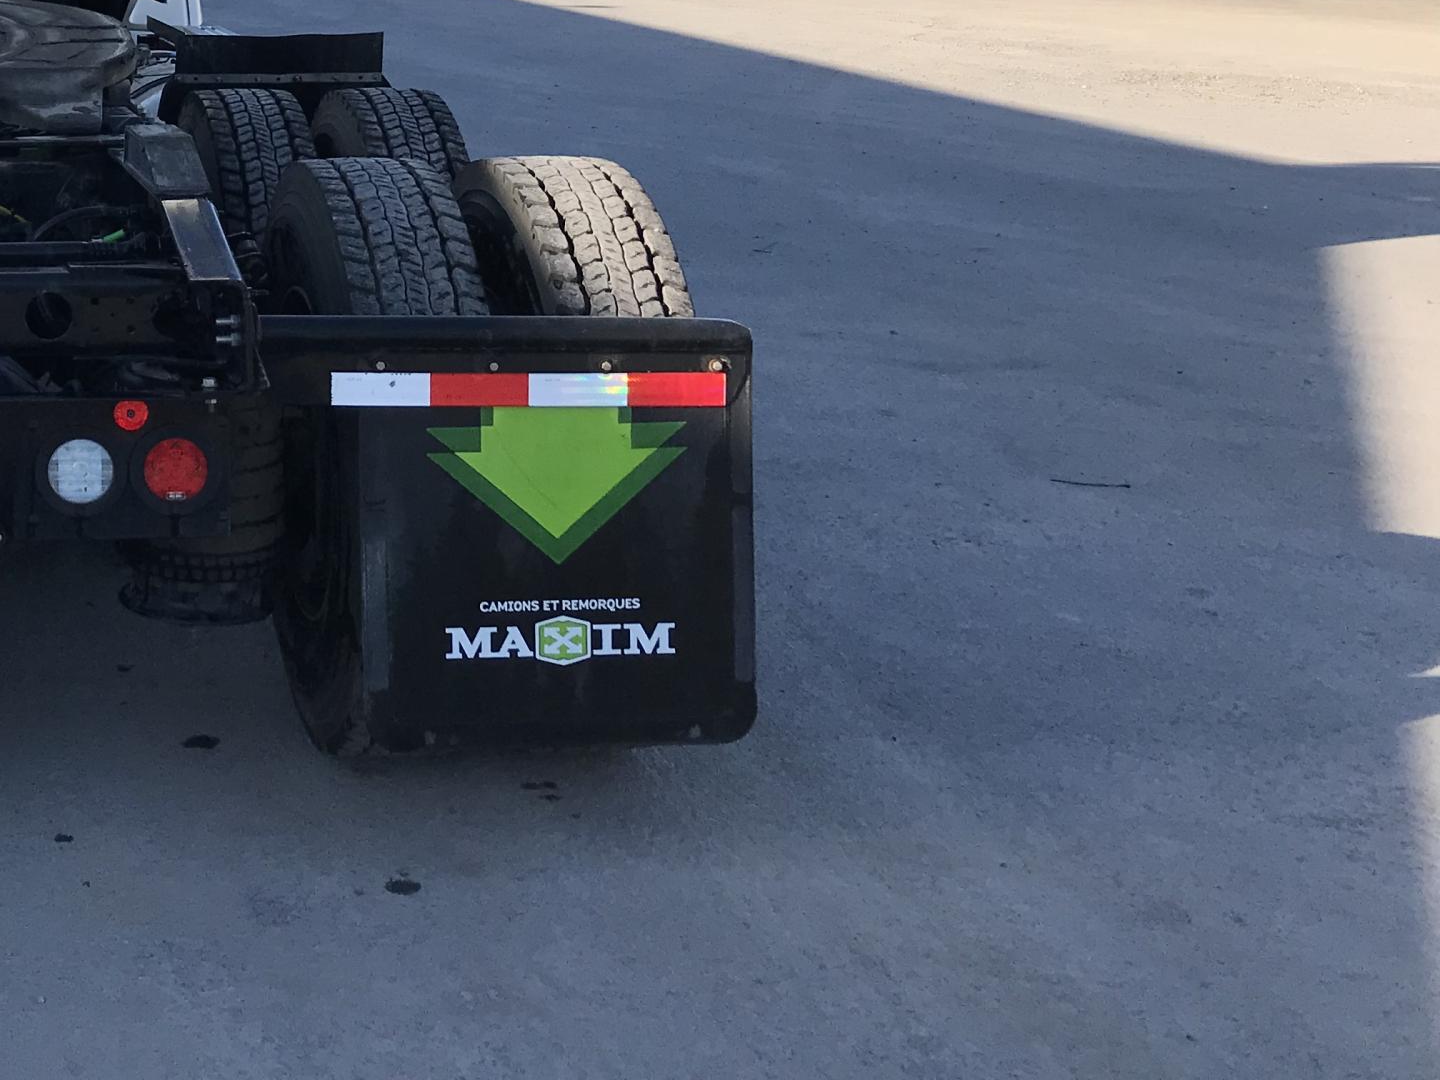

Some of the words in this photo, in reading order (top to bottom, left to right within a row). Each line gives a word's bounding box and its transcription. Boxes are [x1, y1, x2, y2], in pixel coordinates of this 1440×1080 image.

[479, 600, 540, 612] CAMIONS
[542, 600, 560, 611] ET
[561, 598, 641, 612] REMORQUES
[445, 621, 676, 660] MAXIM
